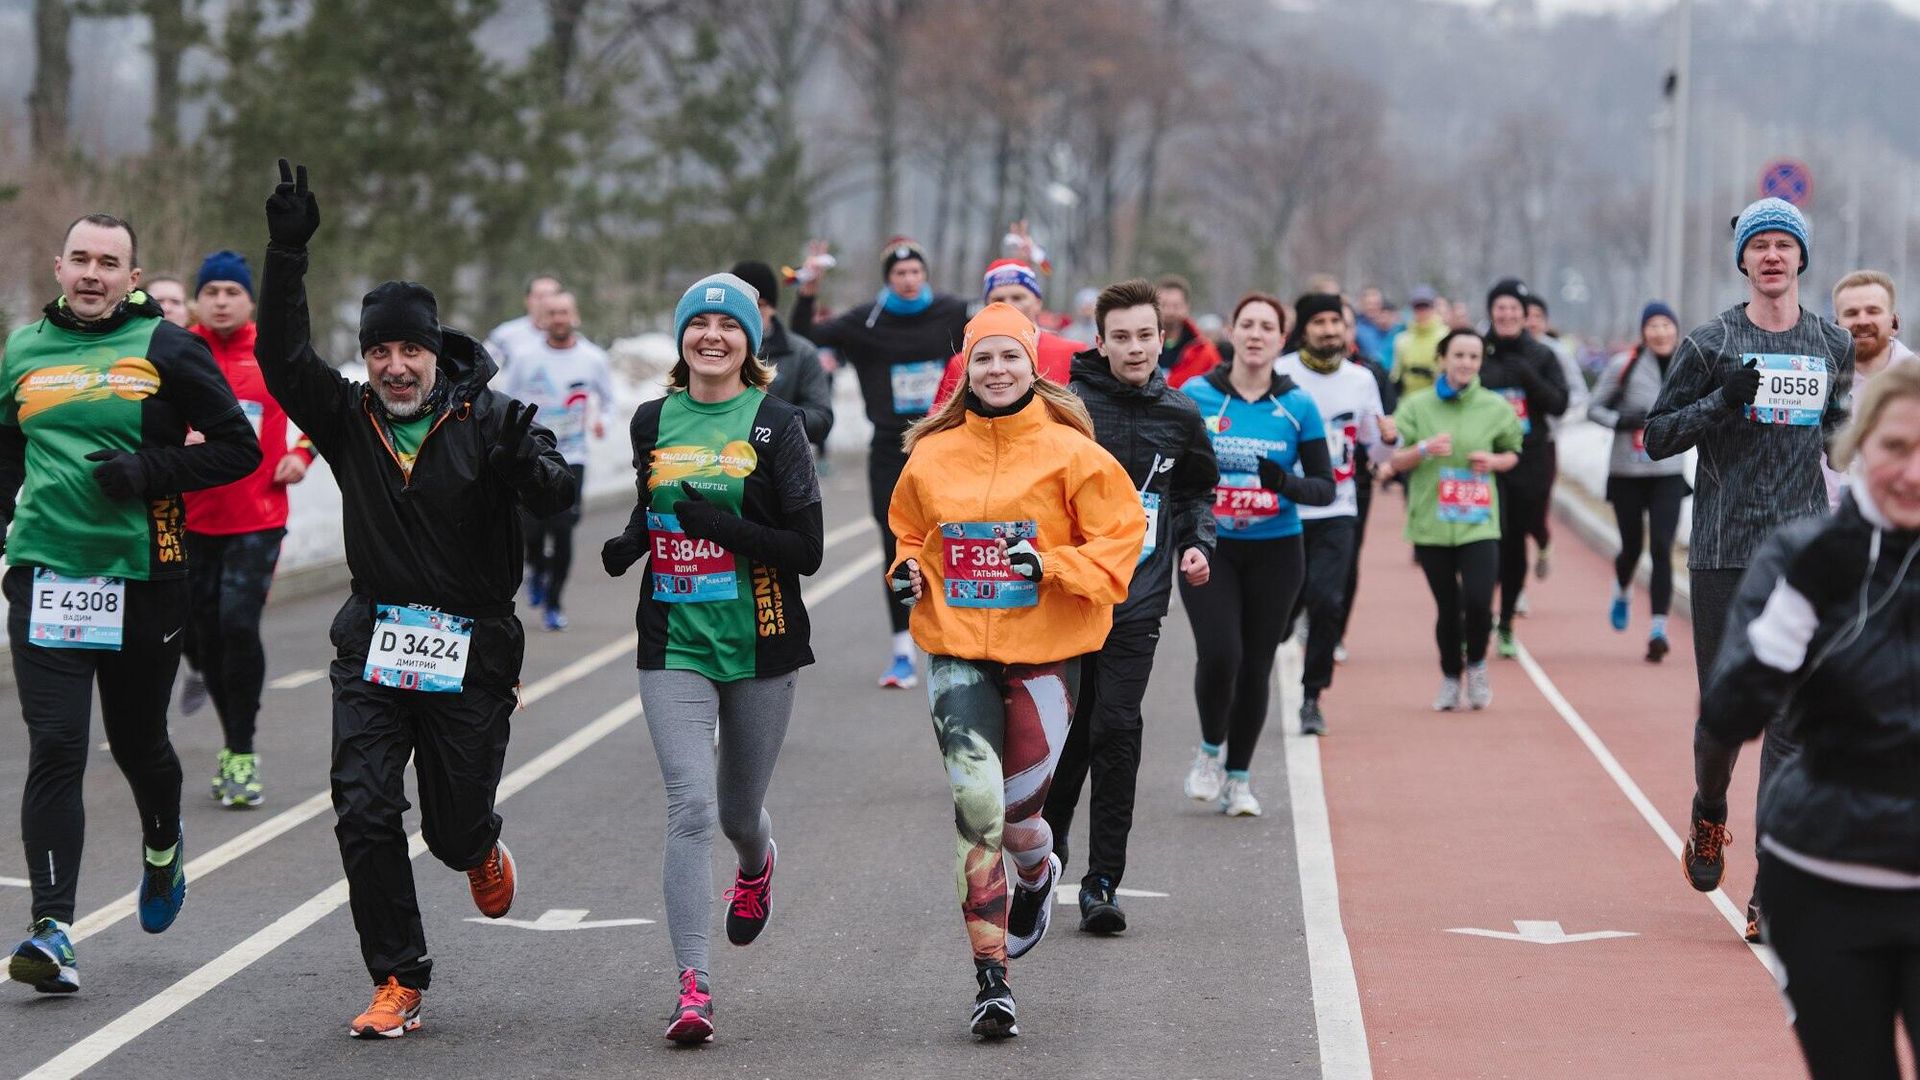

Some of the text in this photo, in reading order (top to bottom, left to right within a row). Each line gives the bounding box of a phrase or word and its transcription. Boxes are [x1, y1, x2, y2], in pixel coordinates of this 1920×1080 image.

[1771, 376, 1819, 396] 0558
[1768, 398, 1802, 406] ЕВГЕНИЙ
[755, 426, 772, 443] 72
[661, 452, 708, 468] running
[1216, 489, 1228, 507] F
[656, 537, 667, 559] E
[951, 545, 1009, 566] F 38
[674, 564, 698, 573] ЮЛИЯ
[972, 570, 1008, 578] ТАТЬЯНА
[40, 590, 118, 612] E 4308
[63, 614, 92, 622] ВАДИМ
[380, 631, 459, 662] D 3424
[395, 658, 437, 670] ДМИТРИЙ
